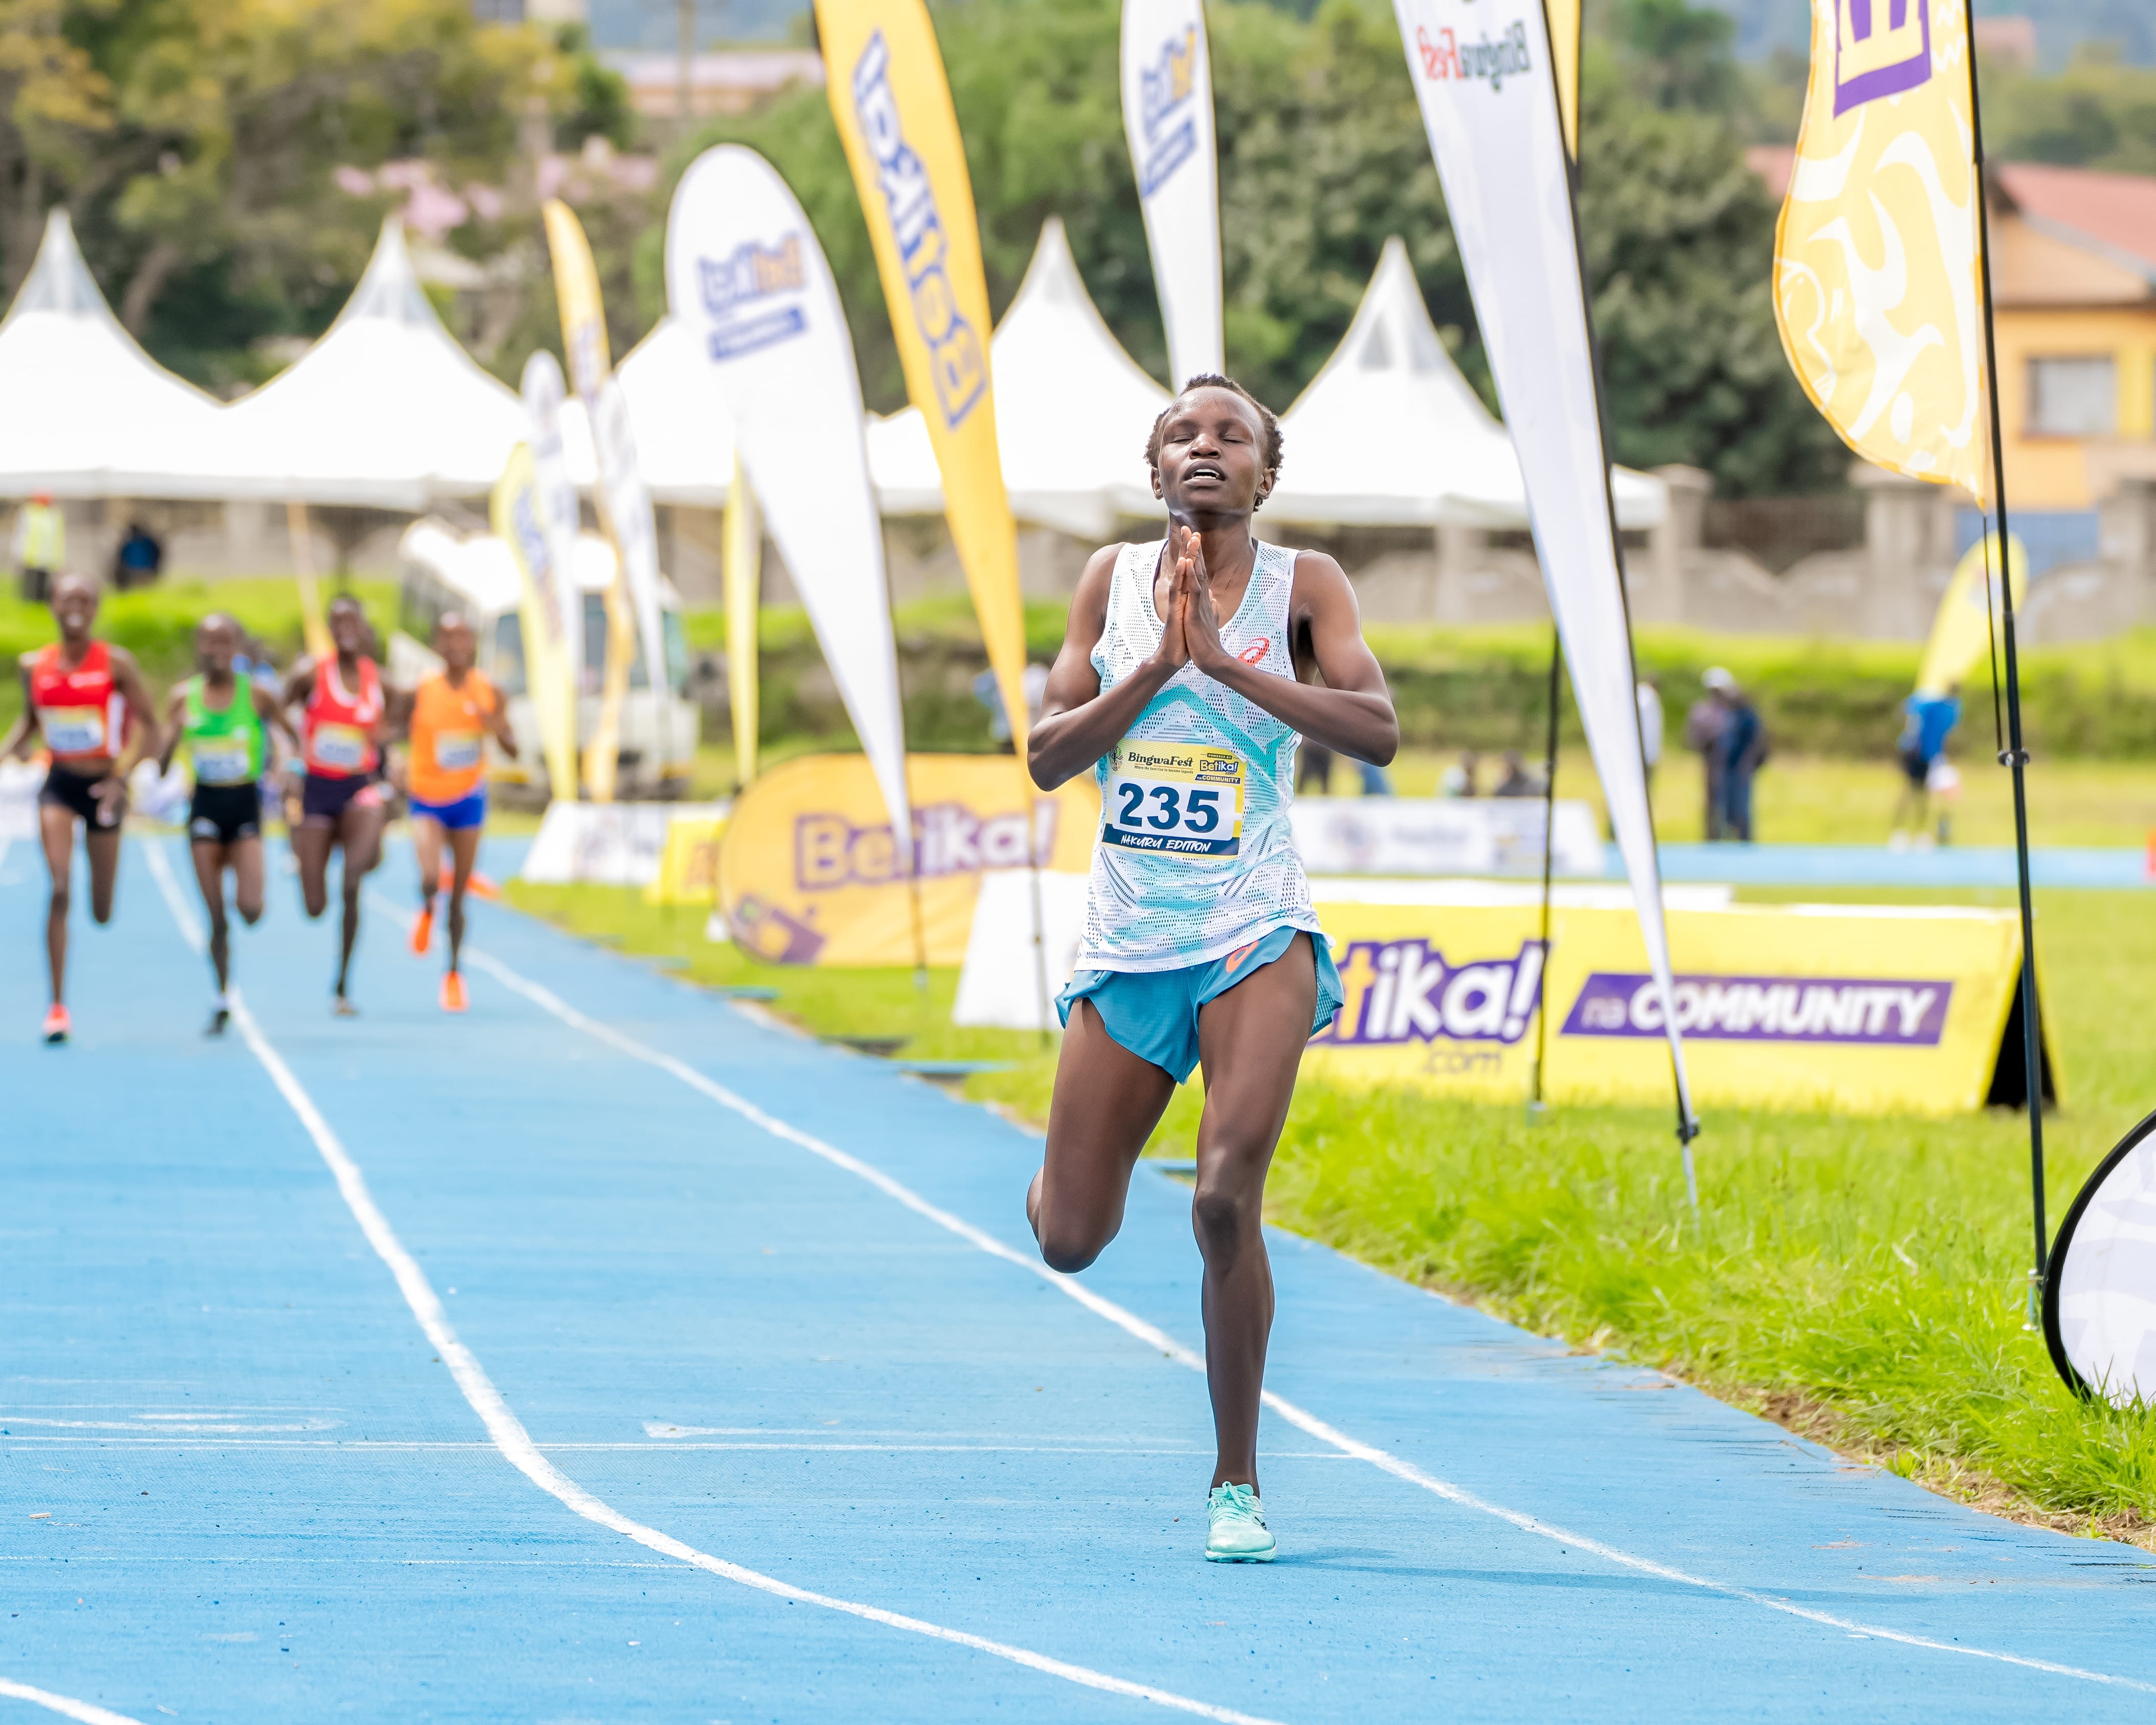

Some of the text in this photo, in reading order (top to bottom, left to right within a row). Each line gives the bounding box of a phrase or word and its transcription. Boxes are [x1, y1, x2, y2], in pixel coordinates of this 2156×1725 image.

[1128, 752, 1194, 767] BingwaFest
[1200, 760, 1238, 772] Betika!
[1202, 775, 1239, 783] COMMUNITY
[1118, 782, 1219, 833] 235
[796, 798, 1054, 891] Beika!
[1120, 834, 1212, 853] NAKURU EDITION
[1310, 943, 1545, 1041] tika!
[1630, 981, 1938, 1038] COMMUNITY
